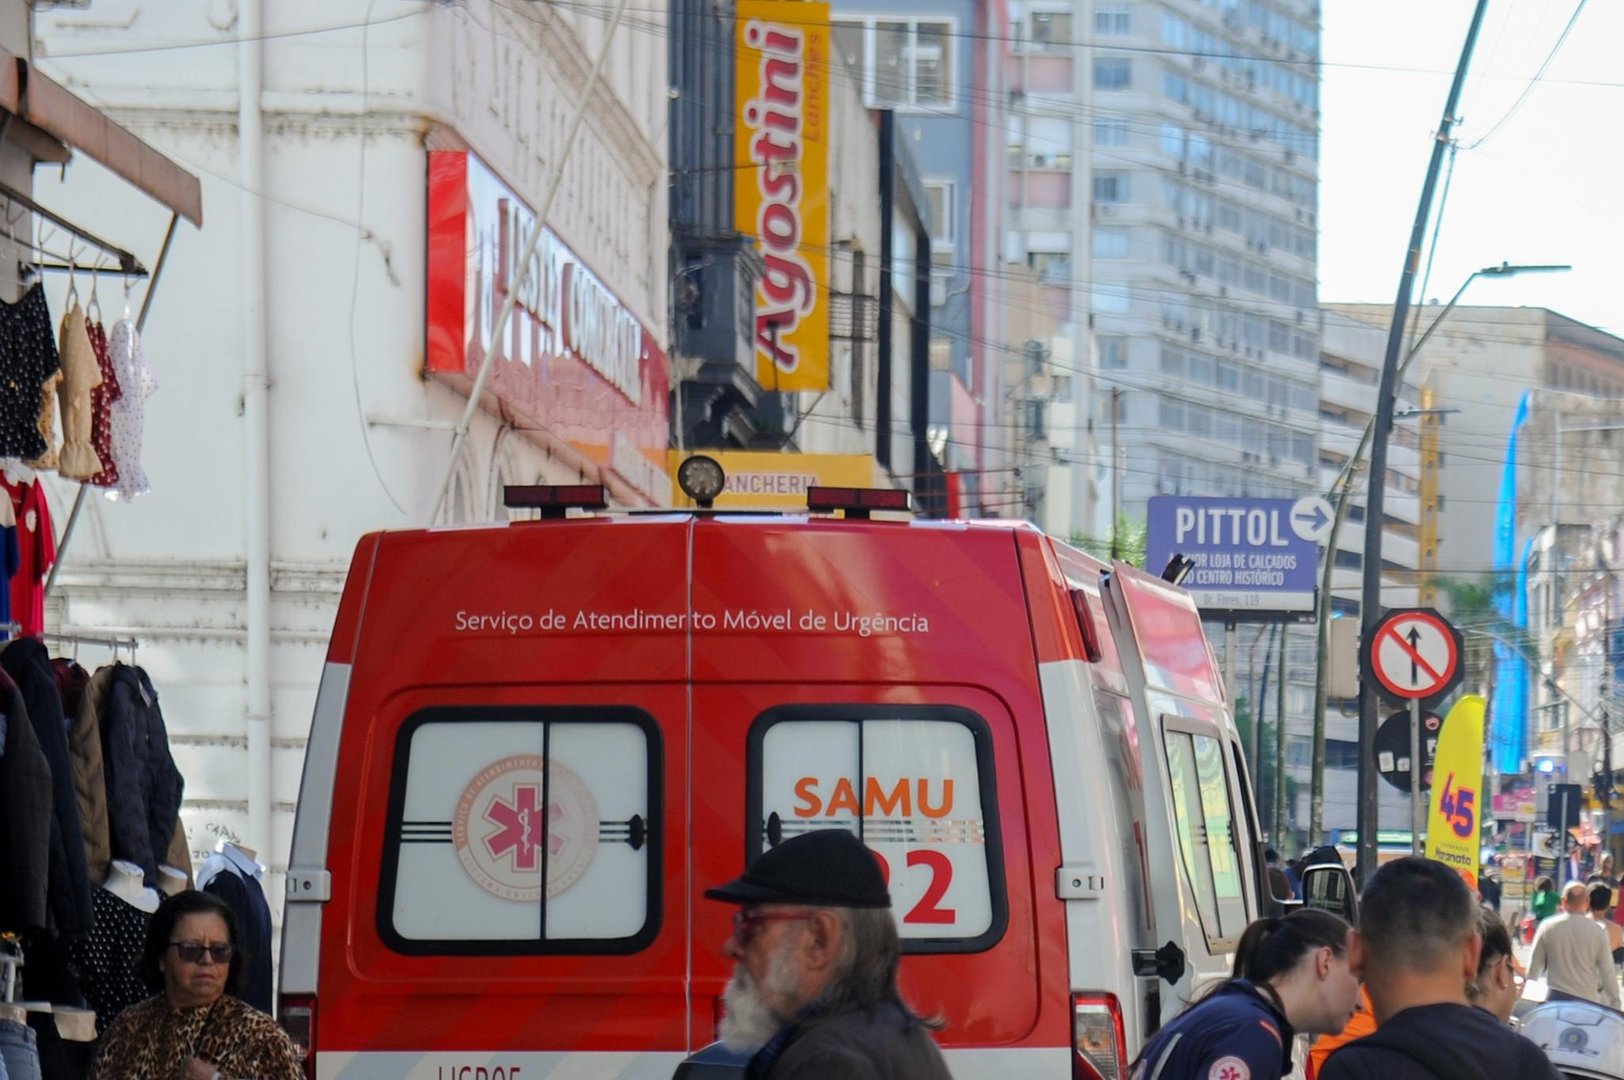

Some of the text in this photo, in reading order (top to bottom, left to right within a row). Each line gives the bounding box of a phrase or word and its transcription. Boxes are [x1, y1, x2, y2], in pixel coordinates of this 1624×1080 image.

[745, 25, 813, 371] Agostini
[723, 474, 817, 494] ANCHERIA
[1175, 507, 1289, 547] PITTOL
[1196, 570, 1233, 585] CENTRO
[1234, 568, 1284, 586] HISTÓRICO
[1209, 554, 1232, 569] LOJA
[1234, 554, 1247, 568] DE
[1248, 555, 1297, 573] CALÇADOS
[455, 609, 929, 637] Serviço de Atendimento Móvel de Urgência
[793, 777, 955, 817] SAMU
[1439, 771, 1475, 840] 45
